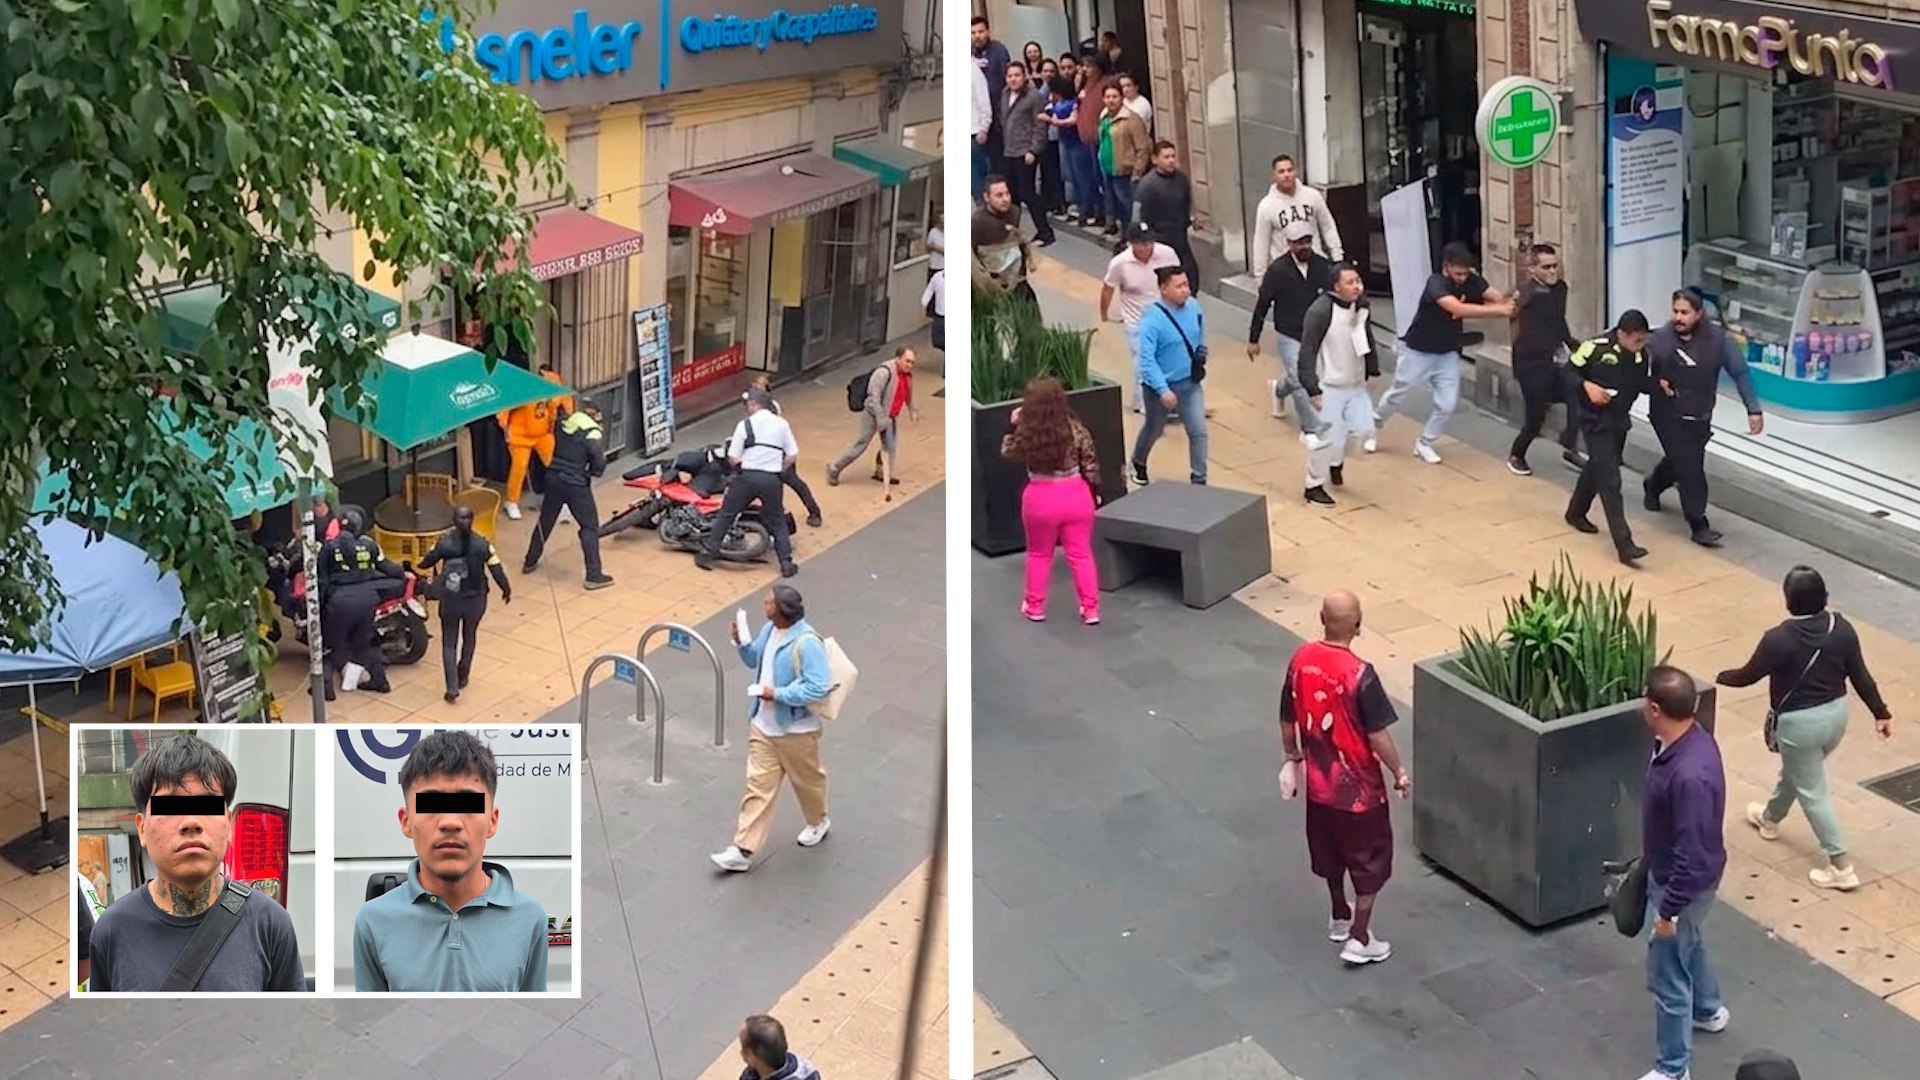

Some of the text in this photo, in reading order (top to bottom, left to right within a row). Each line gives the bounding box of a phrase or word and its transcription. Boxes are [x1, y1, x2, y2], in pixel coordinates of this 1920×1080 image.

[440, 10, 643, 85] sneler
[1278, 203, 1314, 229] GAP
[495, 762, 526, 777] dad
[531, 762, 552, 777] de
